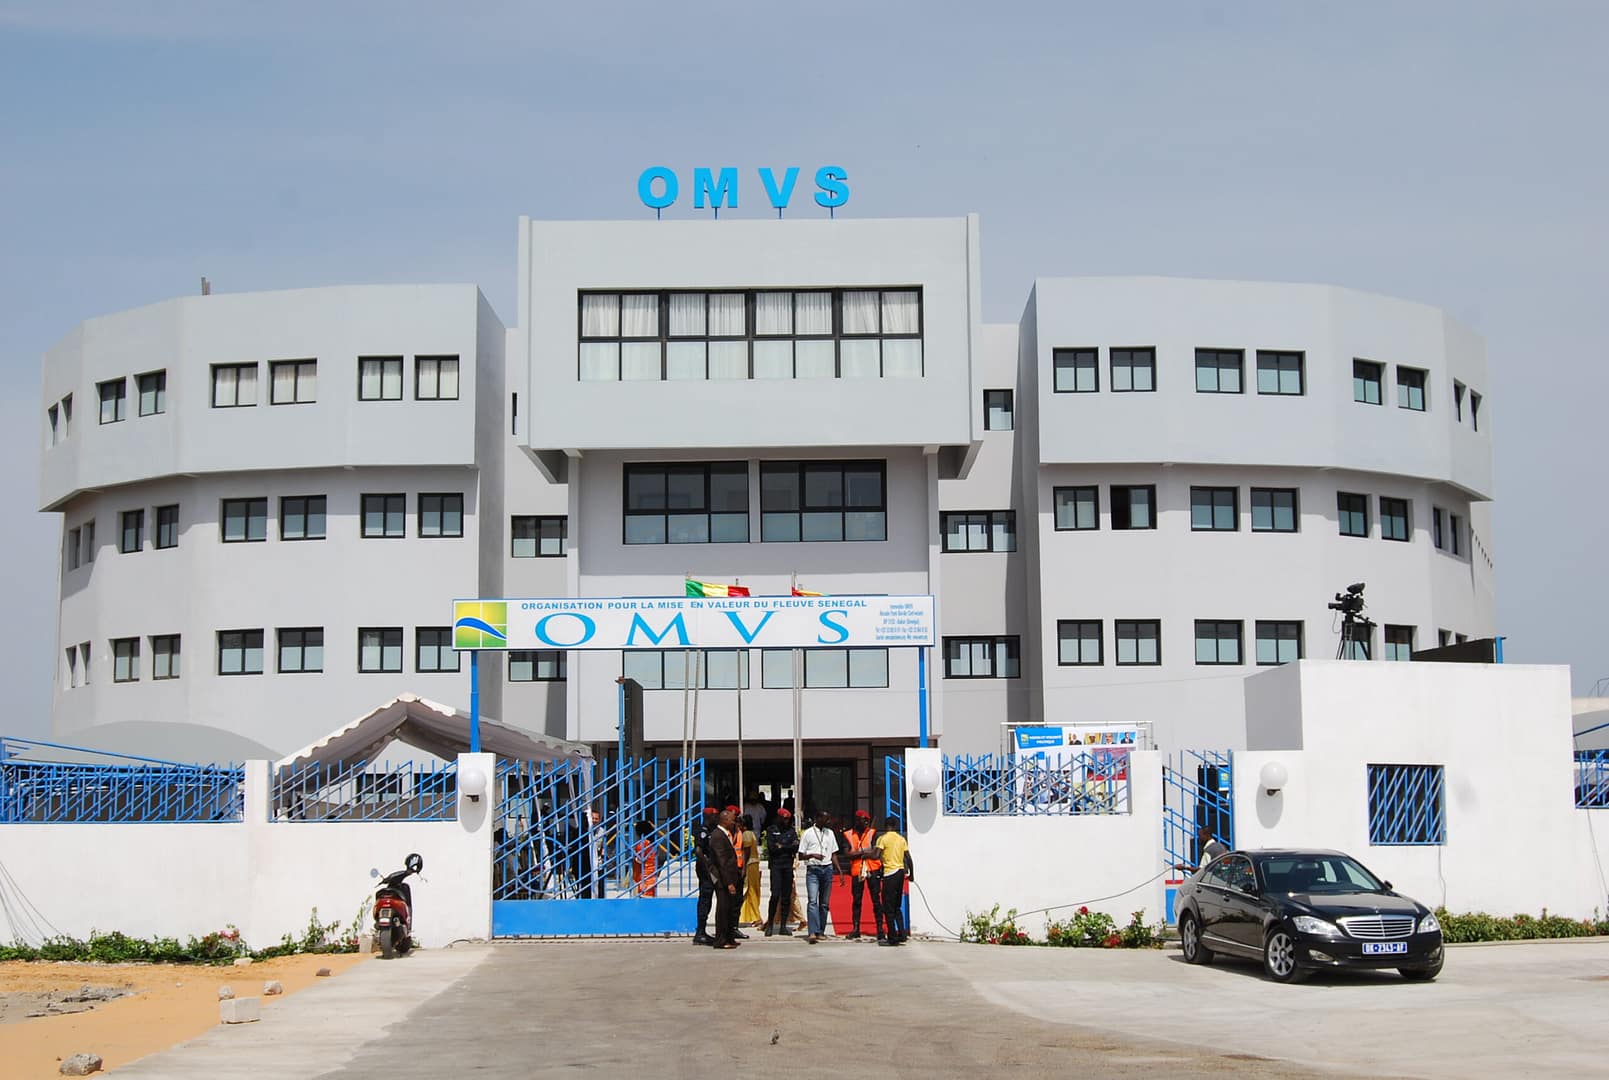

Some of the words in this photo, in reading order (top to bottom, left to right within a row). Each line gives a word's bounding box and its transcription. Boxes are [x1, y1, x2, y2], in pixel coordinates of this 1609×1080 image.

[521, 601, 603, 610] ORGANISATION
[608, 601, 637, 610] POUR
[641, 601, 654, 610] LA
[658, 601, 684, 609] MISE
[690, 601, 704, 609] EN
[708, 601, 750, 609] VALEUR
[773, 600, 814, 608] FLEUVE
[817, 600, 867, 608] SENEGAL
